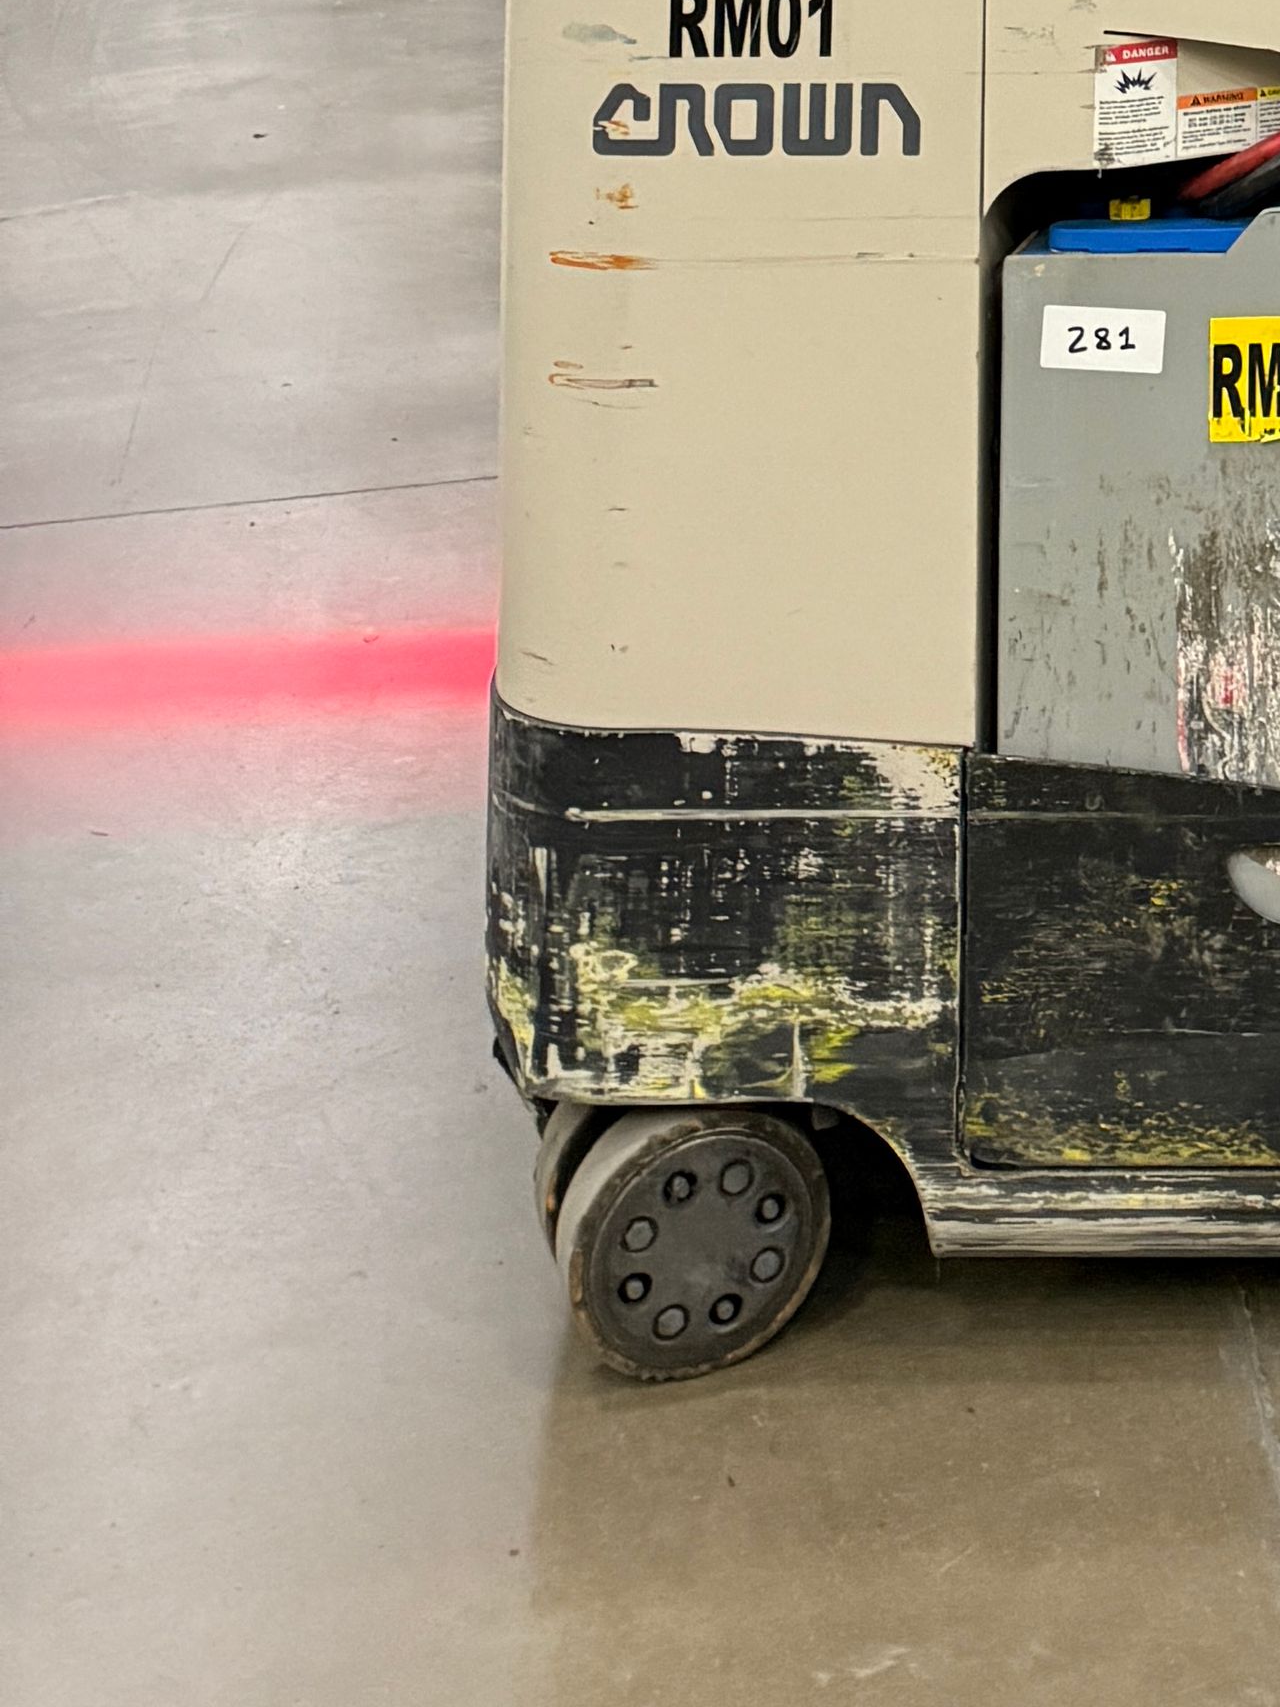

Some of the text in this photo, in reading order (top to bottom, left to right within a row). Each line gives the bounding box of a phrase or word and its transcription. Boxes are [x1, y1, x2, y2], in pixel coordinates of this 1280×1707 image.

[1122, 45, 1170, 60] DANGER
[1202, 91, 1245, 105] WARNING
[592, 82, 922, 157] CROWN
[1066, 324, 1137, 354] 281
